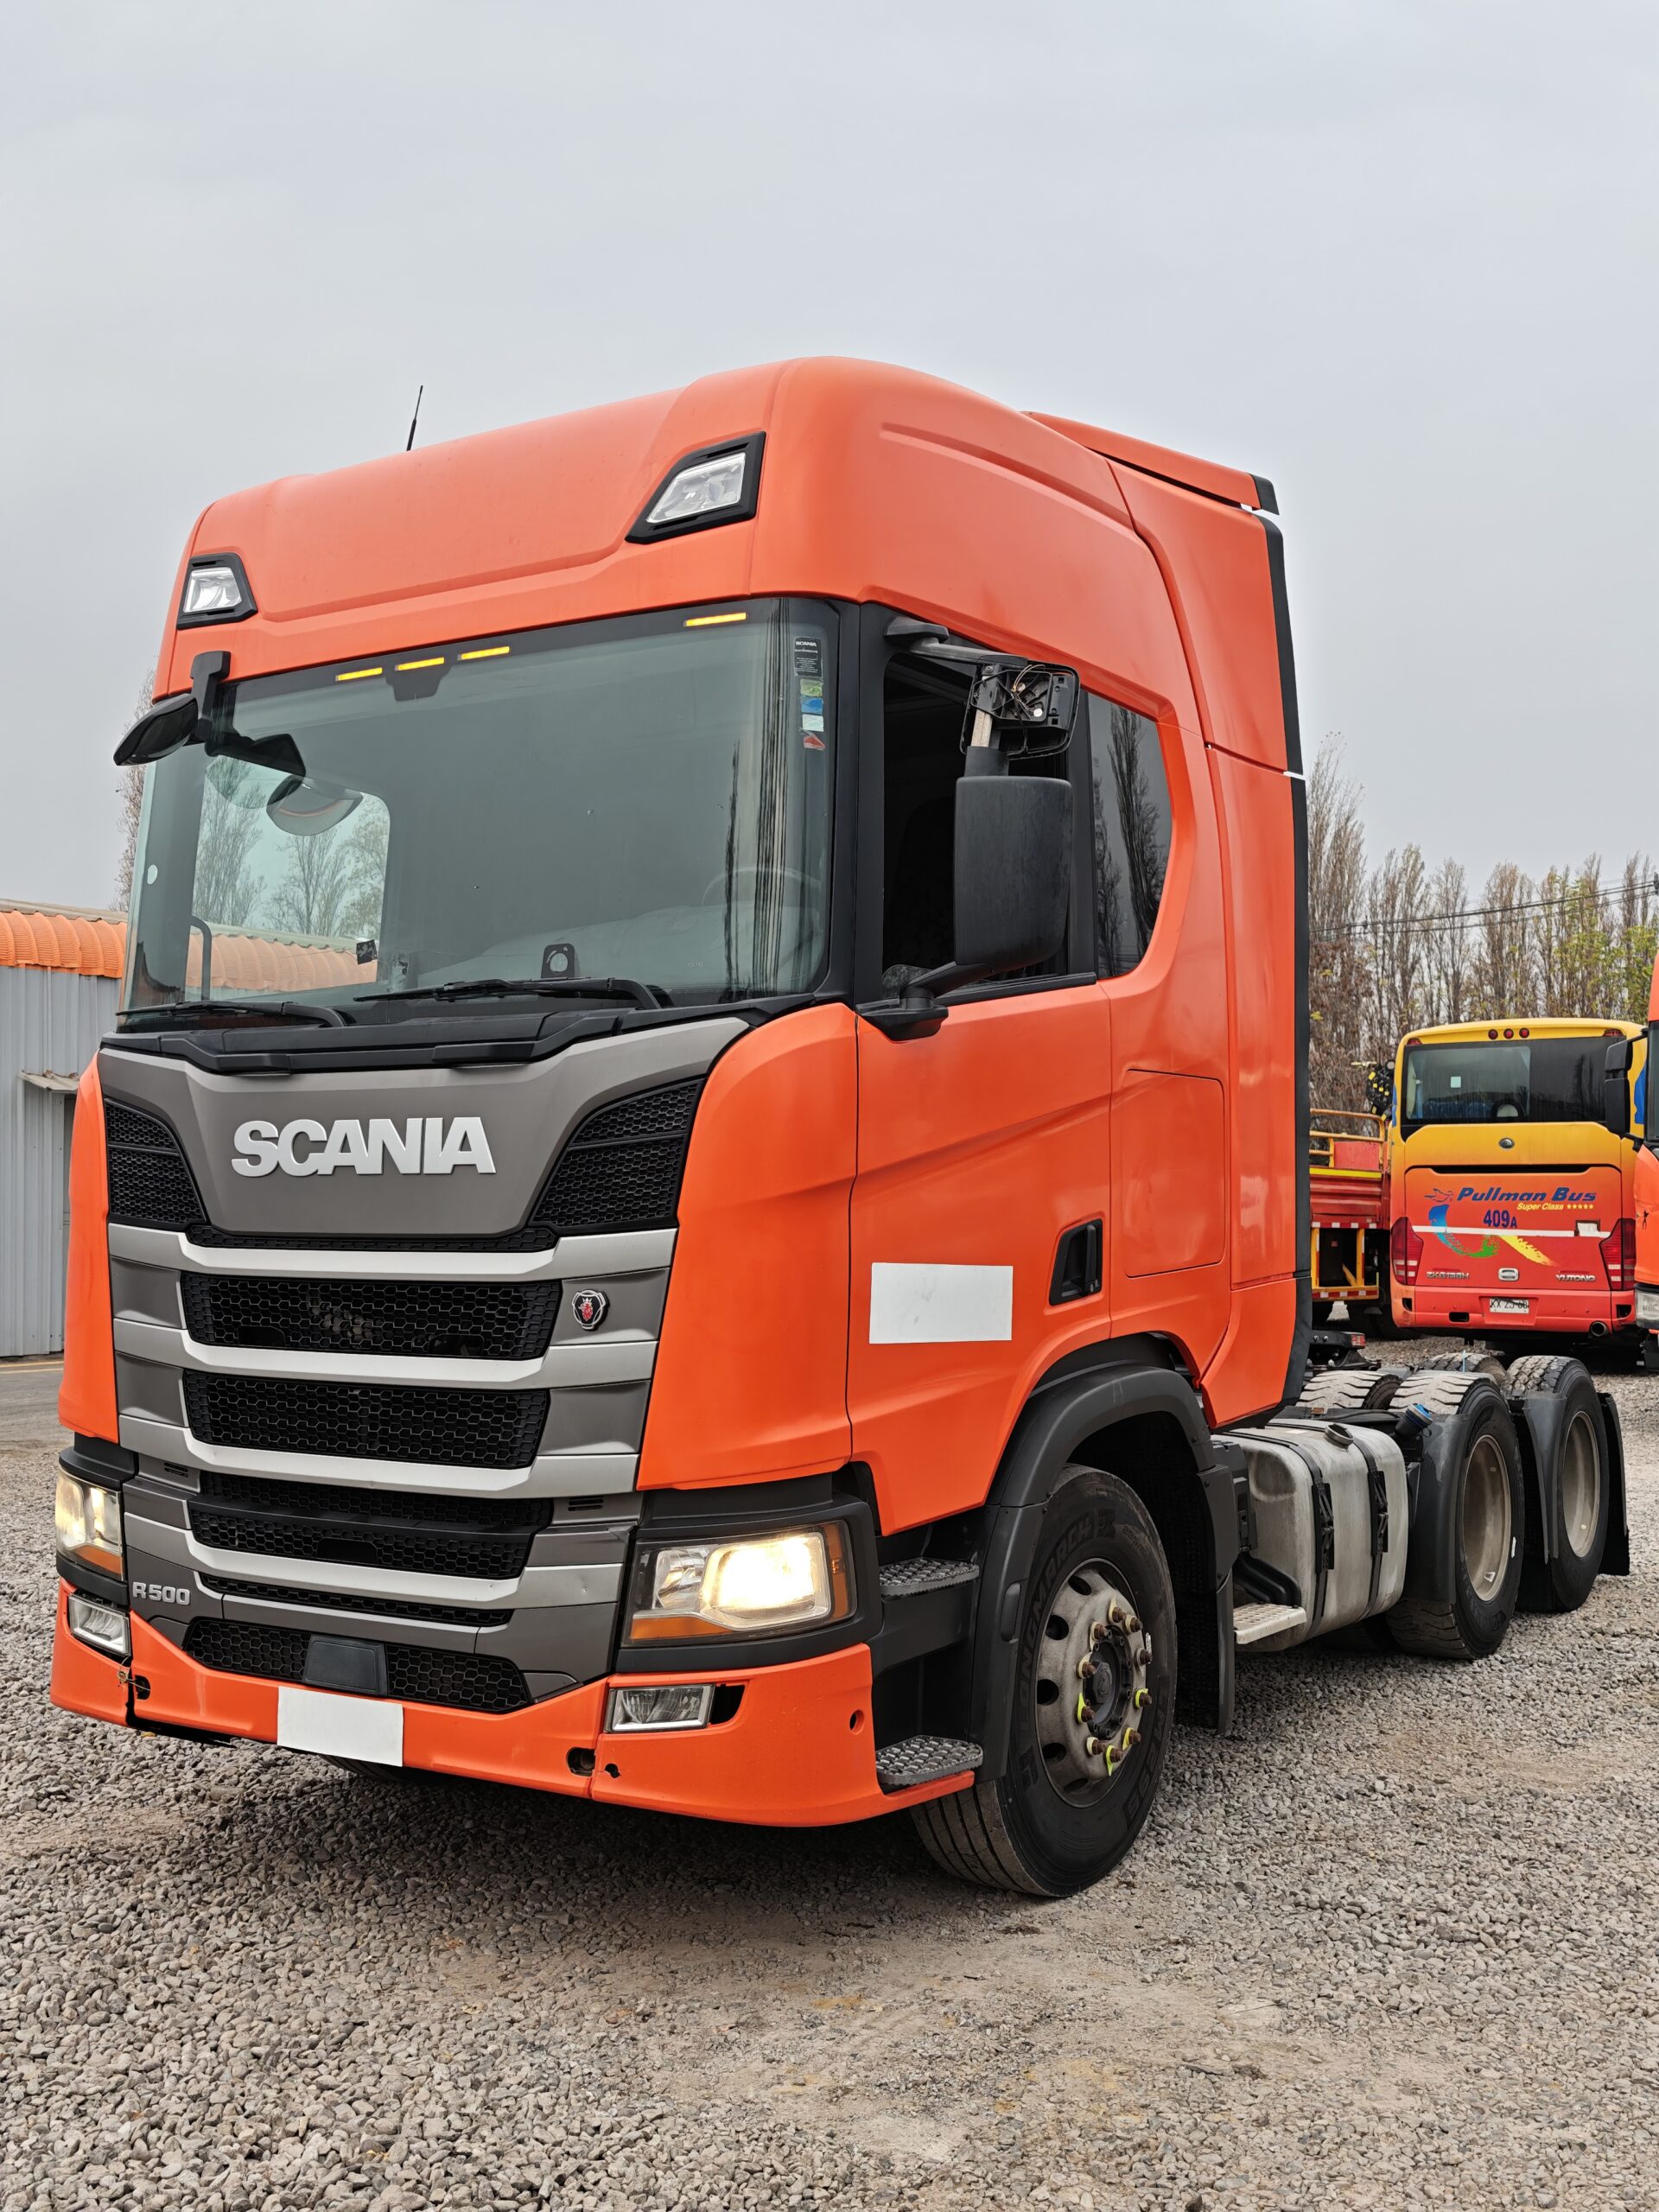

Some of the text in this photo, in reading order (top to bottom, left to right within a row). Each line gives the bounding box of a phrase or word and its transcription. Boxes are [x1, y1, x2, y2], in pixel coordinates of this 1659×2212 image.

[231, 1116, 497, 1178] SCANIA
[1457, 1186, 1598, 1202] Pullman Bus
[1516, 1202, 1565, 1211] Super Class
[1555, 1274, 1596, 1282] YUTONG
